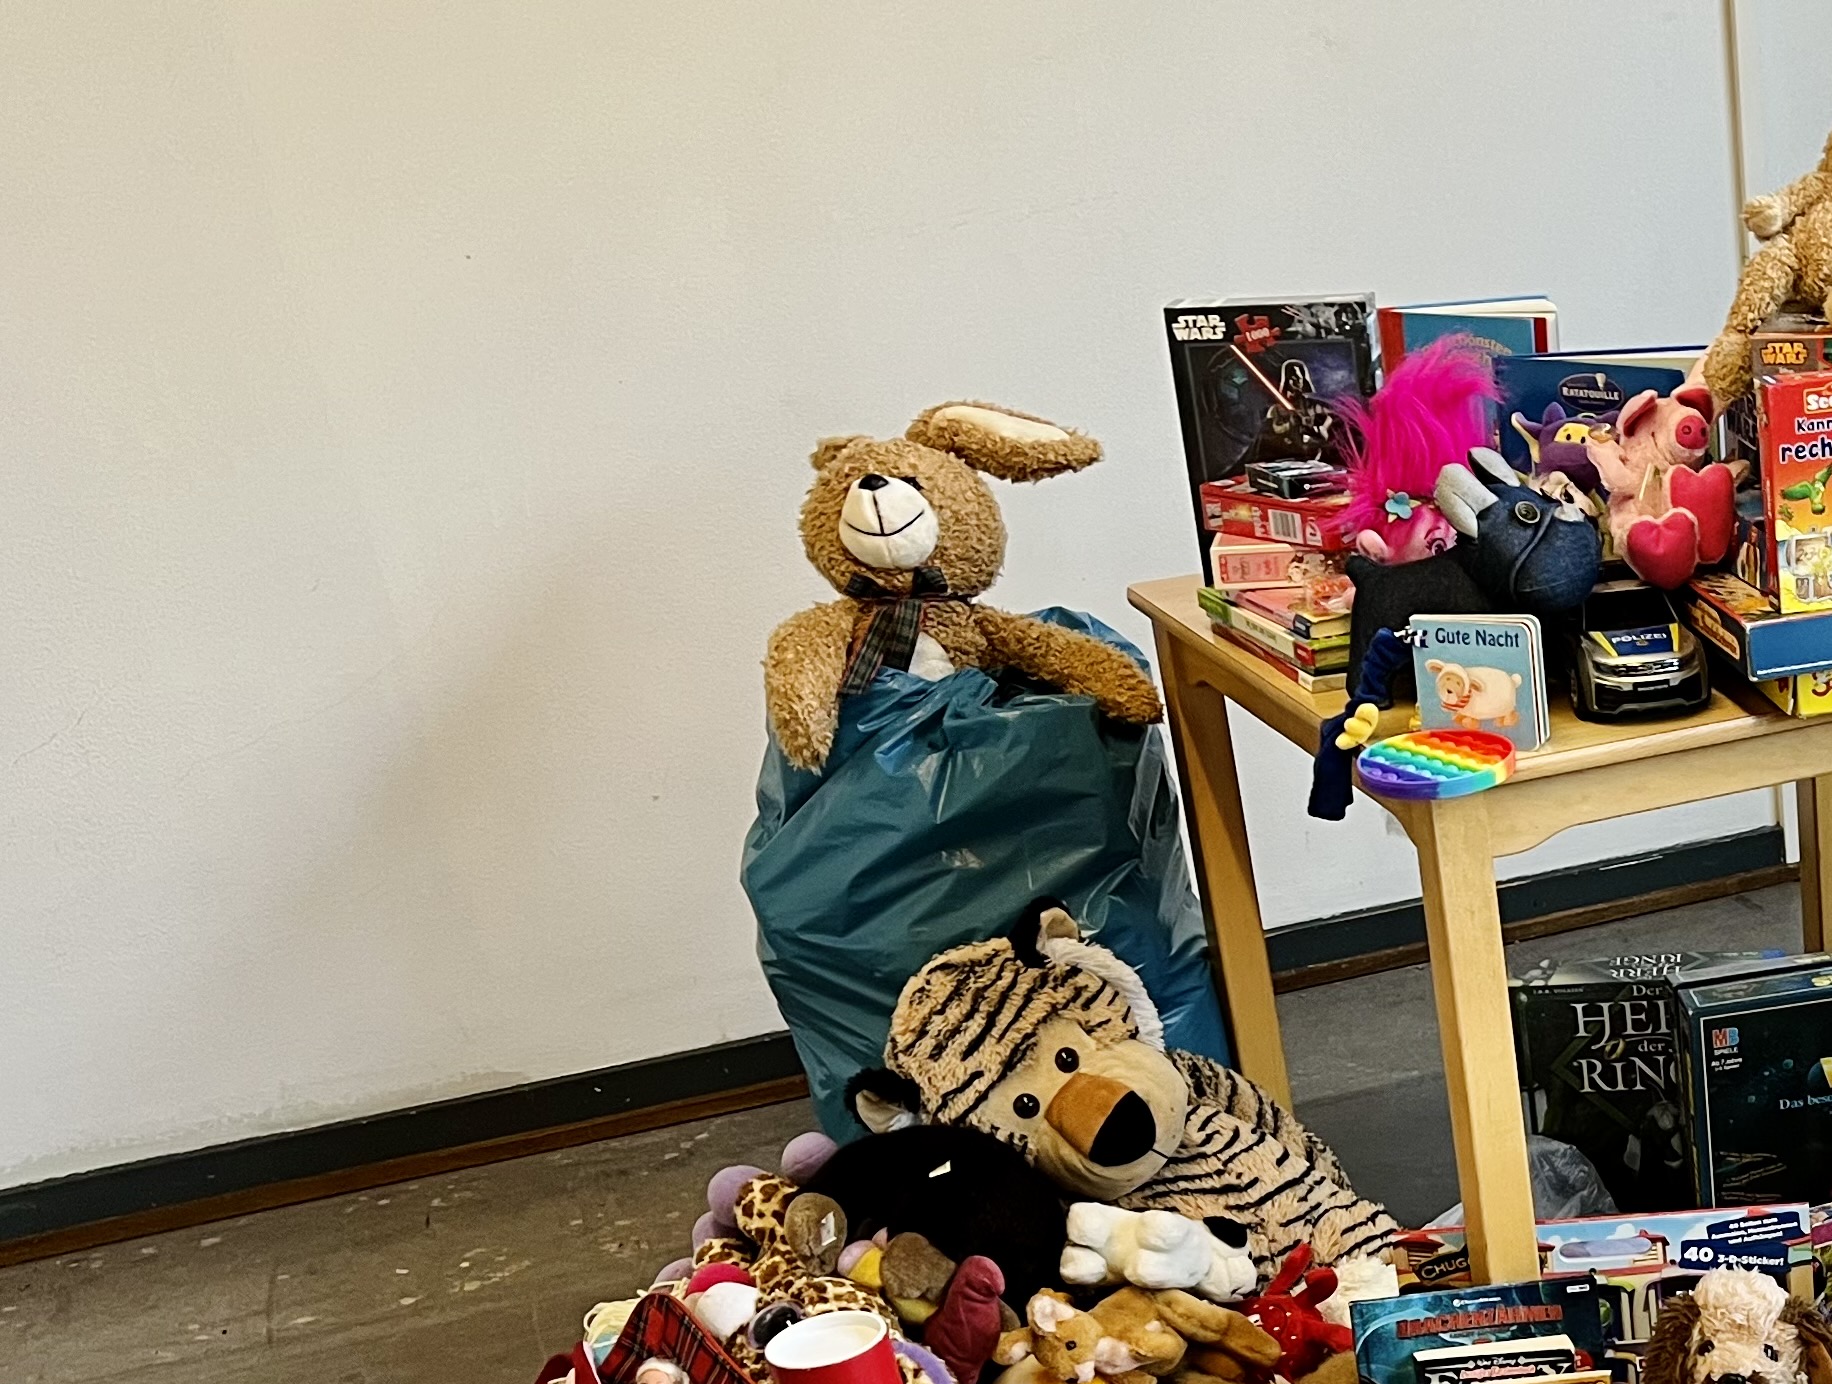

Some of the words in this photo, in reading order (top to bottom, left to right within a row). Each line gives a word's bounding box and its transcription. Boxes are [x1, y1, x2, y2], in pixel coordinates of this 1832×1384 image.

[1176, 314, 1225, 329] STAR
[1172, 327, 1227, 342] WARS
[1244, 326, 1272, 342] 1000
[1766, 341, 1804, 353] STAR
[1761, 350, 1808, 365] WARS
[1435, 627, 1472, 647] Gute
[1477, 628, 1521, 649] Nacht
[1611, 631, 1668, 644] POLIZEI
[1632, 984, 1664, 997] Der
[1569, 1000, 1673, 1050] HE
[1711, 1027, 1740, 1048] MB
[1638, 1040, 1666, 1053] der
[1572, 1055, 1677, 1093] RIN
[1778, 1096, 1805, 1112] Das
[1683, 1246, 1714, 1263] 40
[1717, 1253, 1785, 1267] 3-D-Sticker!
[1420, 1256, 1470, 1280] CHUG
